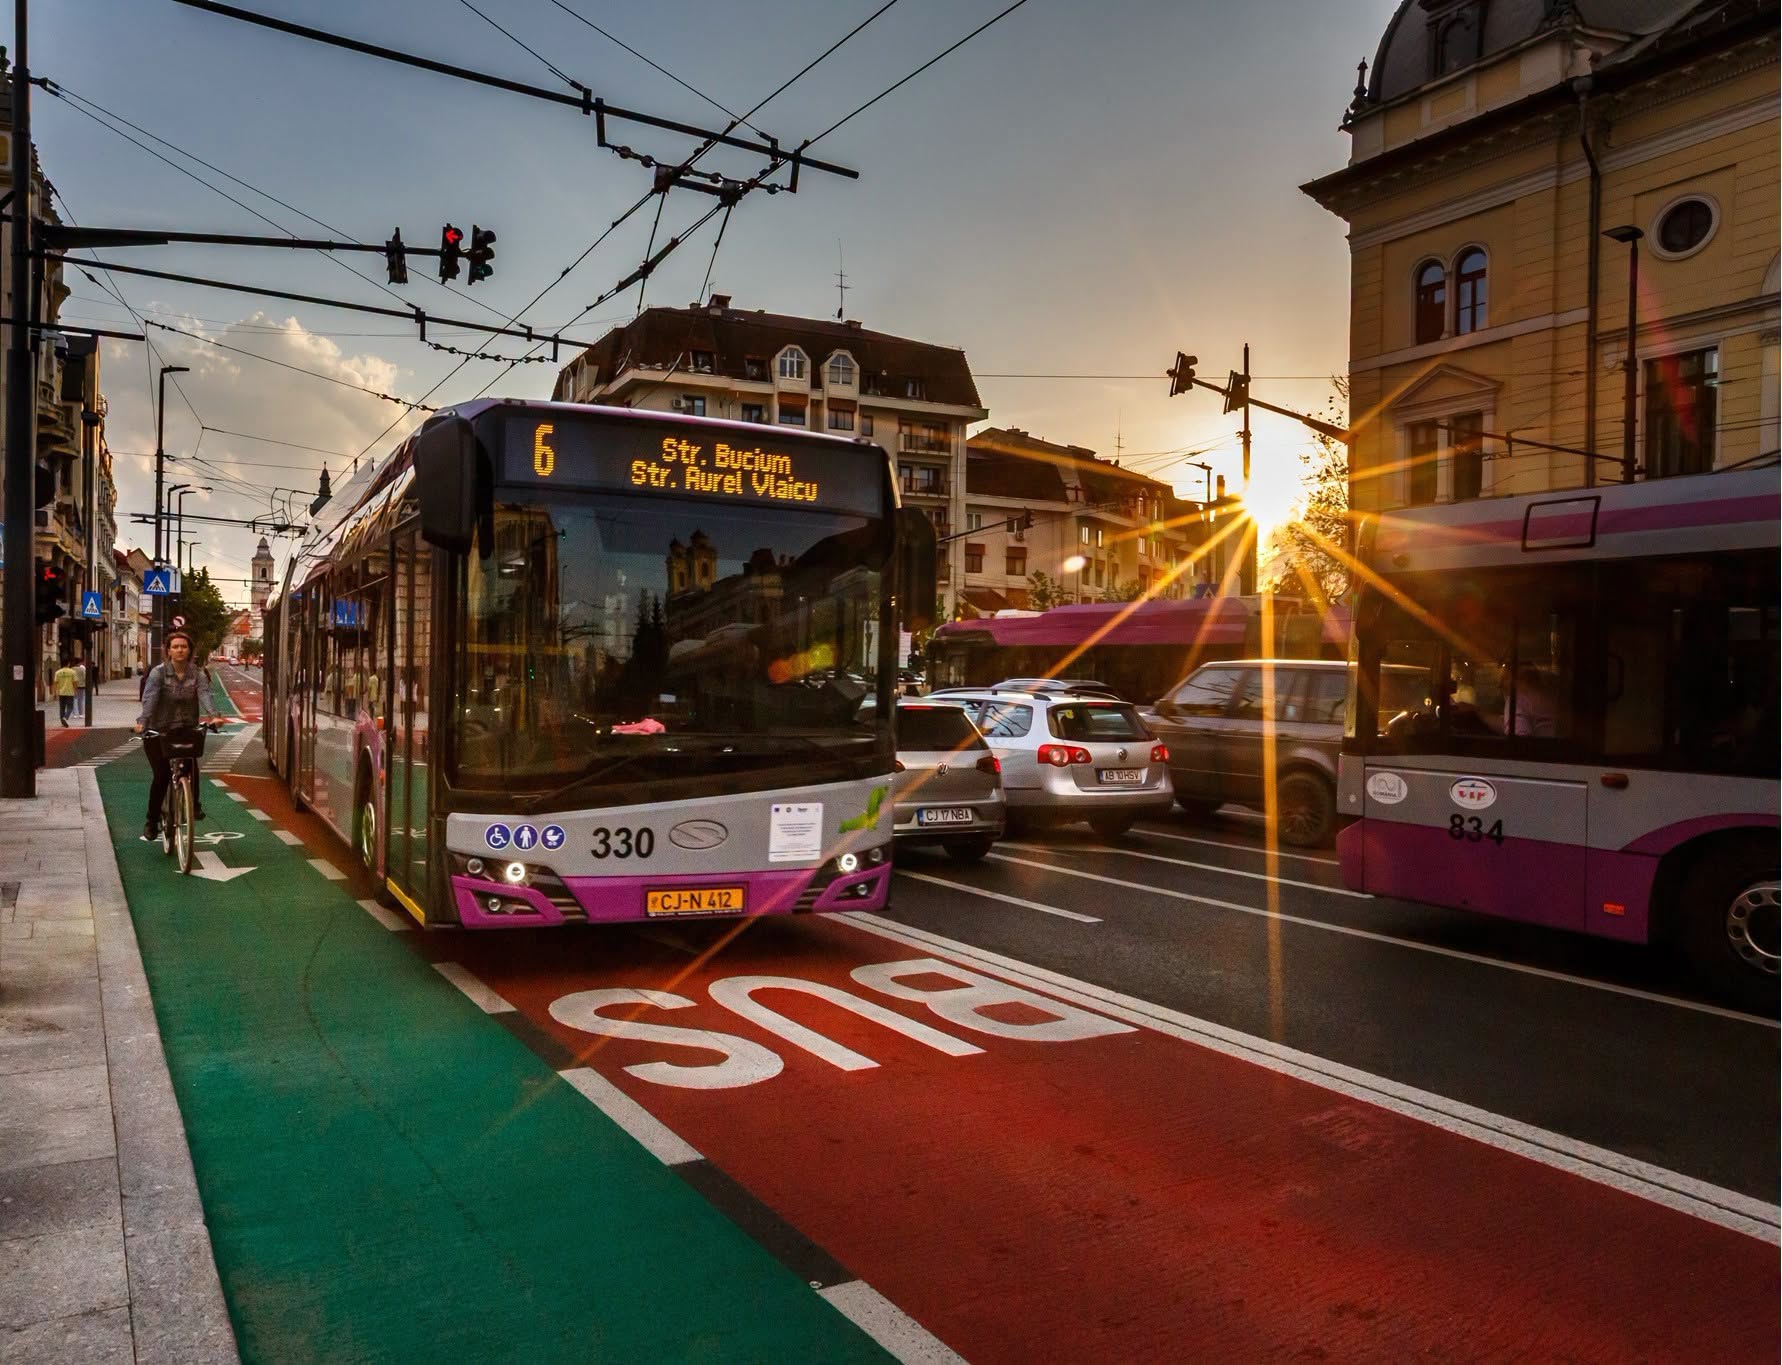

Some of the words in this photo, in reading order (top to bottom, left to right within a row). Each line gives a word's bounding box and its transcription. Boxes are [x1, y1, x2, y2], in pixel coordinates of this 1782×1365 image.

[534, 424, 555, 476] 6
[662, 438, 707, 466] Str.
[715, 443, 791, 475] Bucium
[631, 460, 677, 488] Str.
[685, 466, 744, 495] Aurel
[751, 472, 818, 502] Vlaicu
[950, 809, 970, 820] NBA
[1449, 814, 1504, 847] 834
[591, 827, 655, 859] 330
[661, 893, 702, 910] CJ-N
[707, 891, 732, 908] 412
[548, 957, 1140, 1090] BUS
